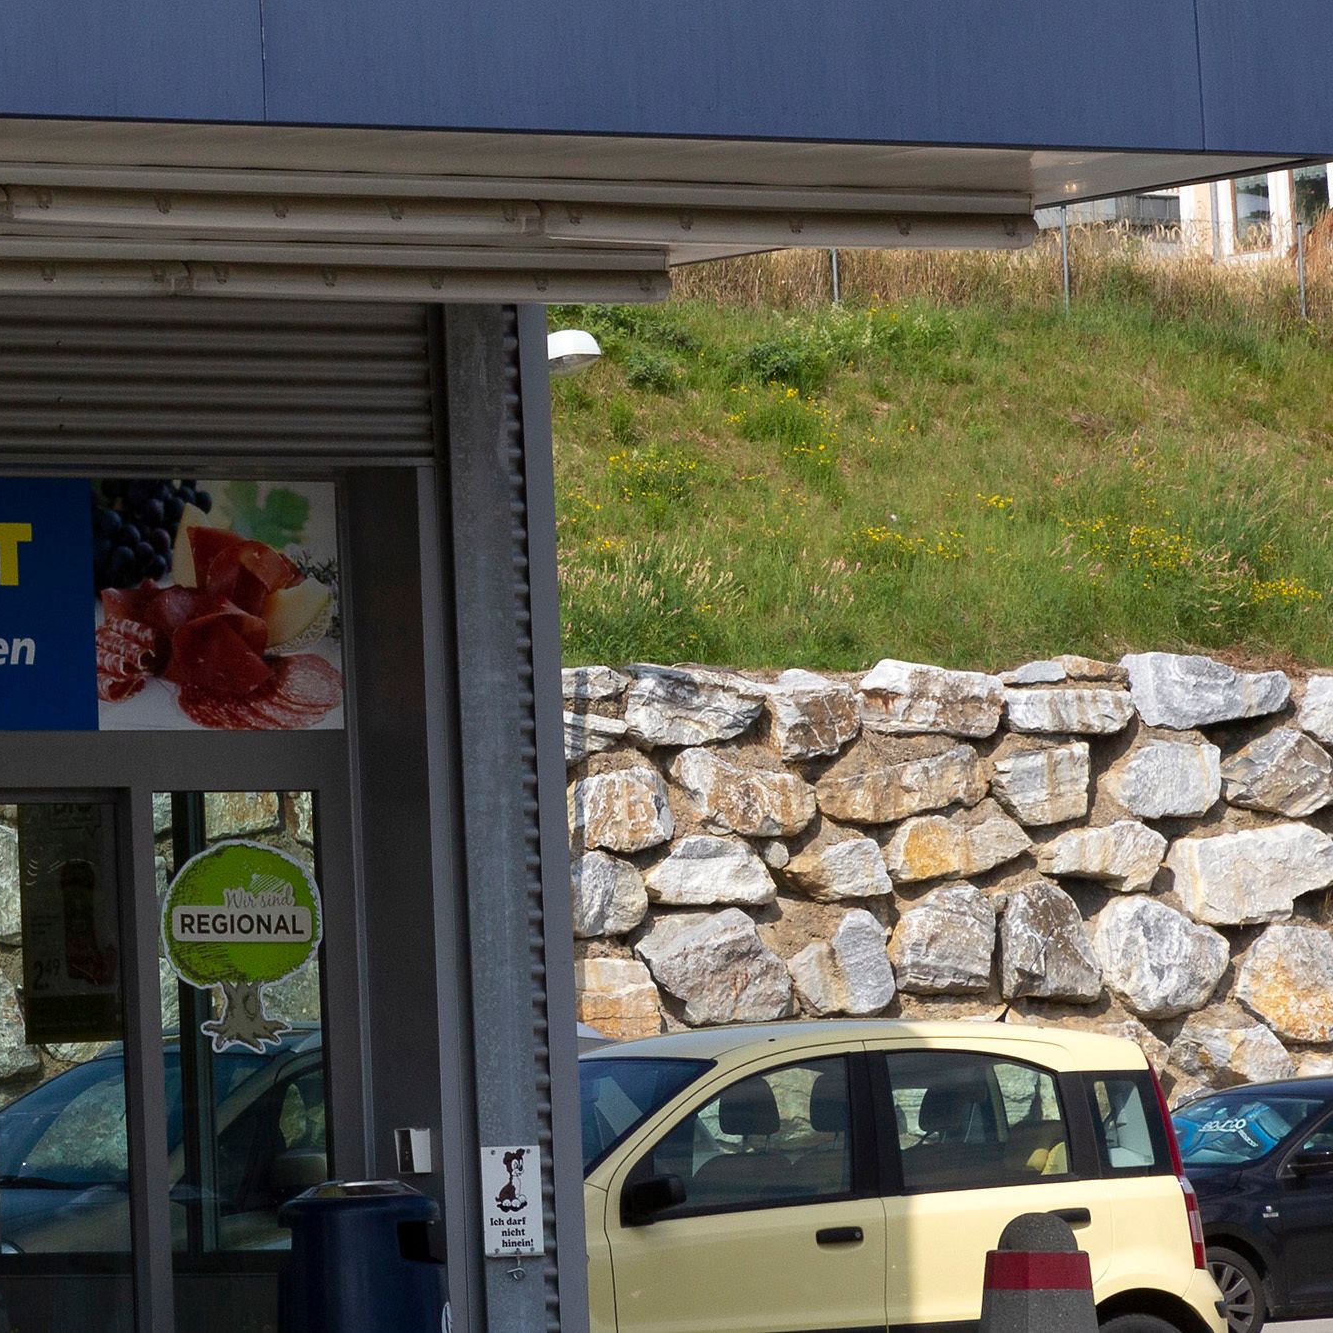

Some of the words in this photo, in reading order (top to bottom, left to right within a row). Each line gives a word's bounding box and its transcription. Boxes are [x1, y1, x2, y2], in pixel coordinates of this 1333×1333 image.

[226, 889, 257, 908] Wir
[260, 884, 293, 908] sind
[180, 913, 304, 934] REGIONAL
[490, 1217, 505, 1226] Ich
[506, 1216, 526, 1226] darf
[501, 1228, 526, 1237] nicht
[502, 1238, 534, 1248] hinein!
